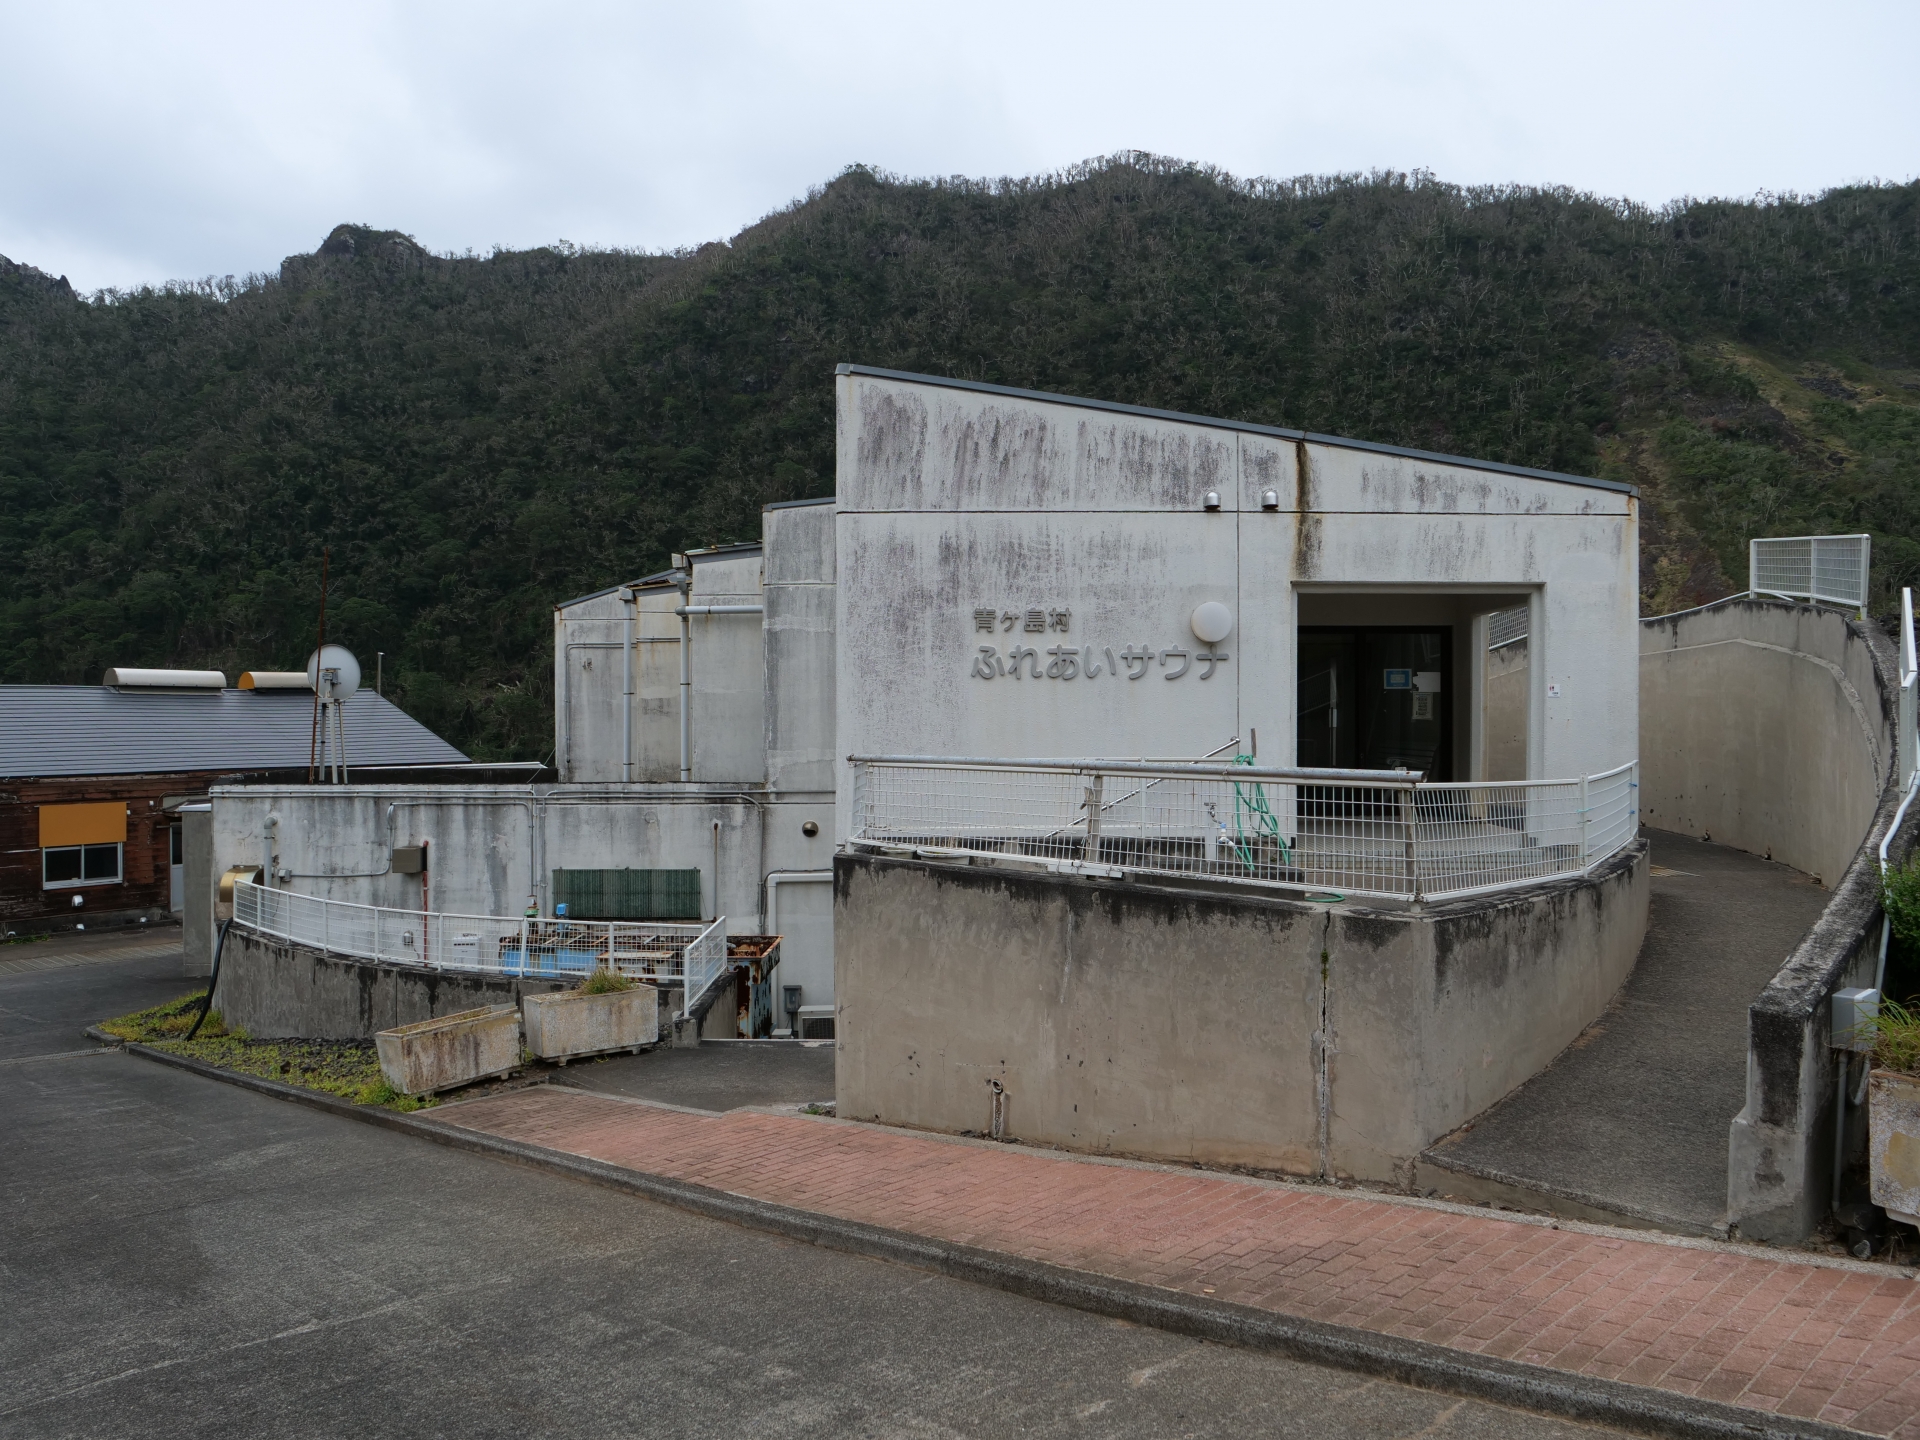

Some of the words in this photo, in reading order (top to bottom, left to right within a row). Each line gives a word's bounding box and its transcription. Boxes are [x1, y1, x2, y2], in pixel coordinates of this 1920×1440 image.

[971, 643, 1230, 680] ふれあいサウナ
